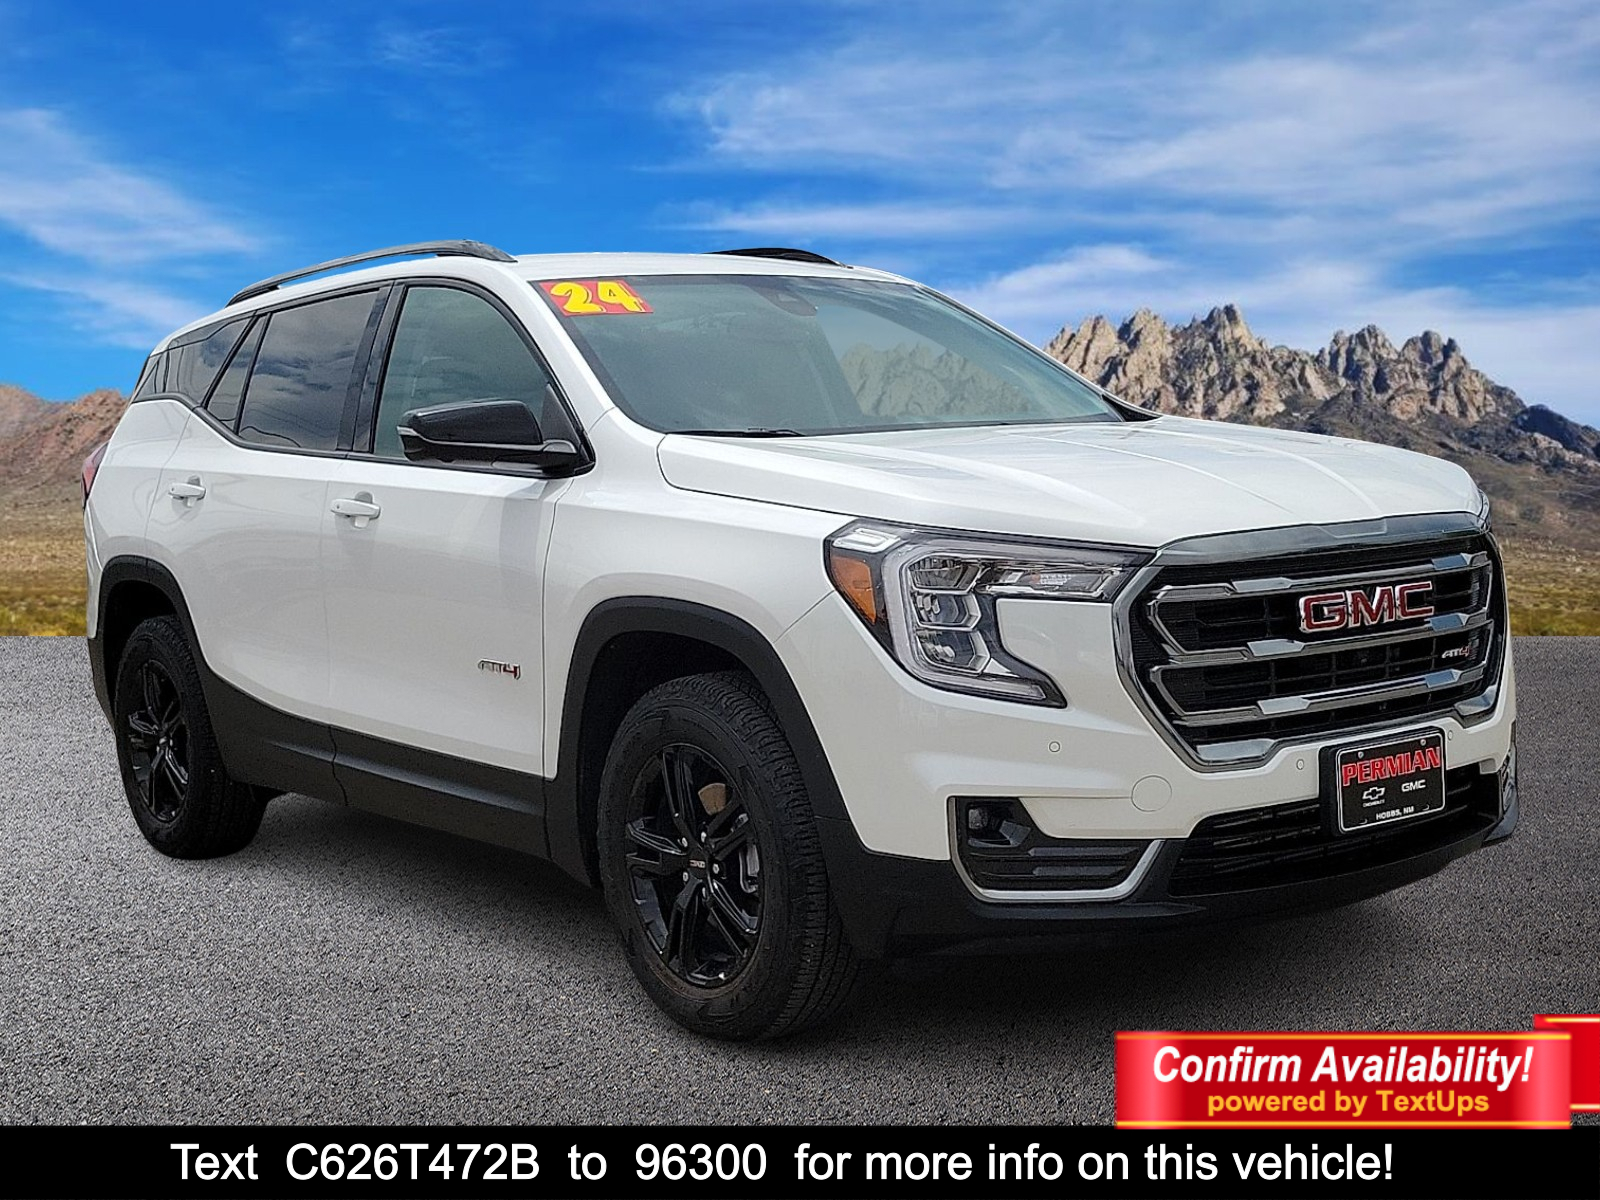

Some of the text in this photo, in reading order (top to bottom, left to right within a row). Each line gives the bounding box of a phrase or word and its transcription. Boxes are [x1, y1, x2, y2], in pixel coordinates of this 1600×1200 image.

[550, 281, 646, 313] 24
[1299, 581, 1435, 633] GMC
[1342, 747, 1441, 786] PERMIAN
[1401, 779, 1426, 792] GMC
[1403, 806, 1414, 815] NM
